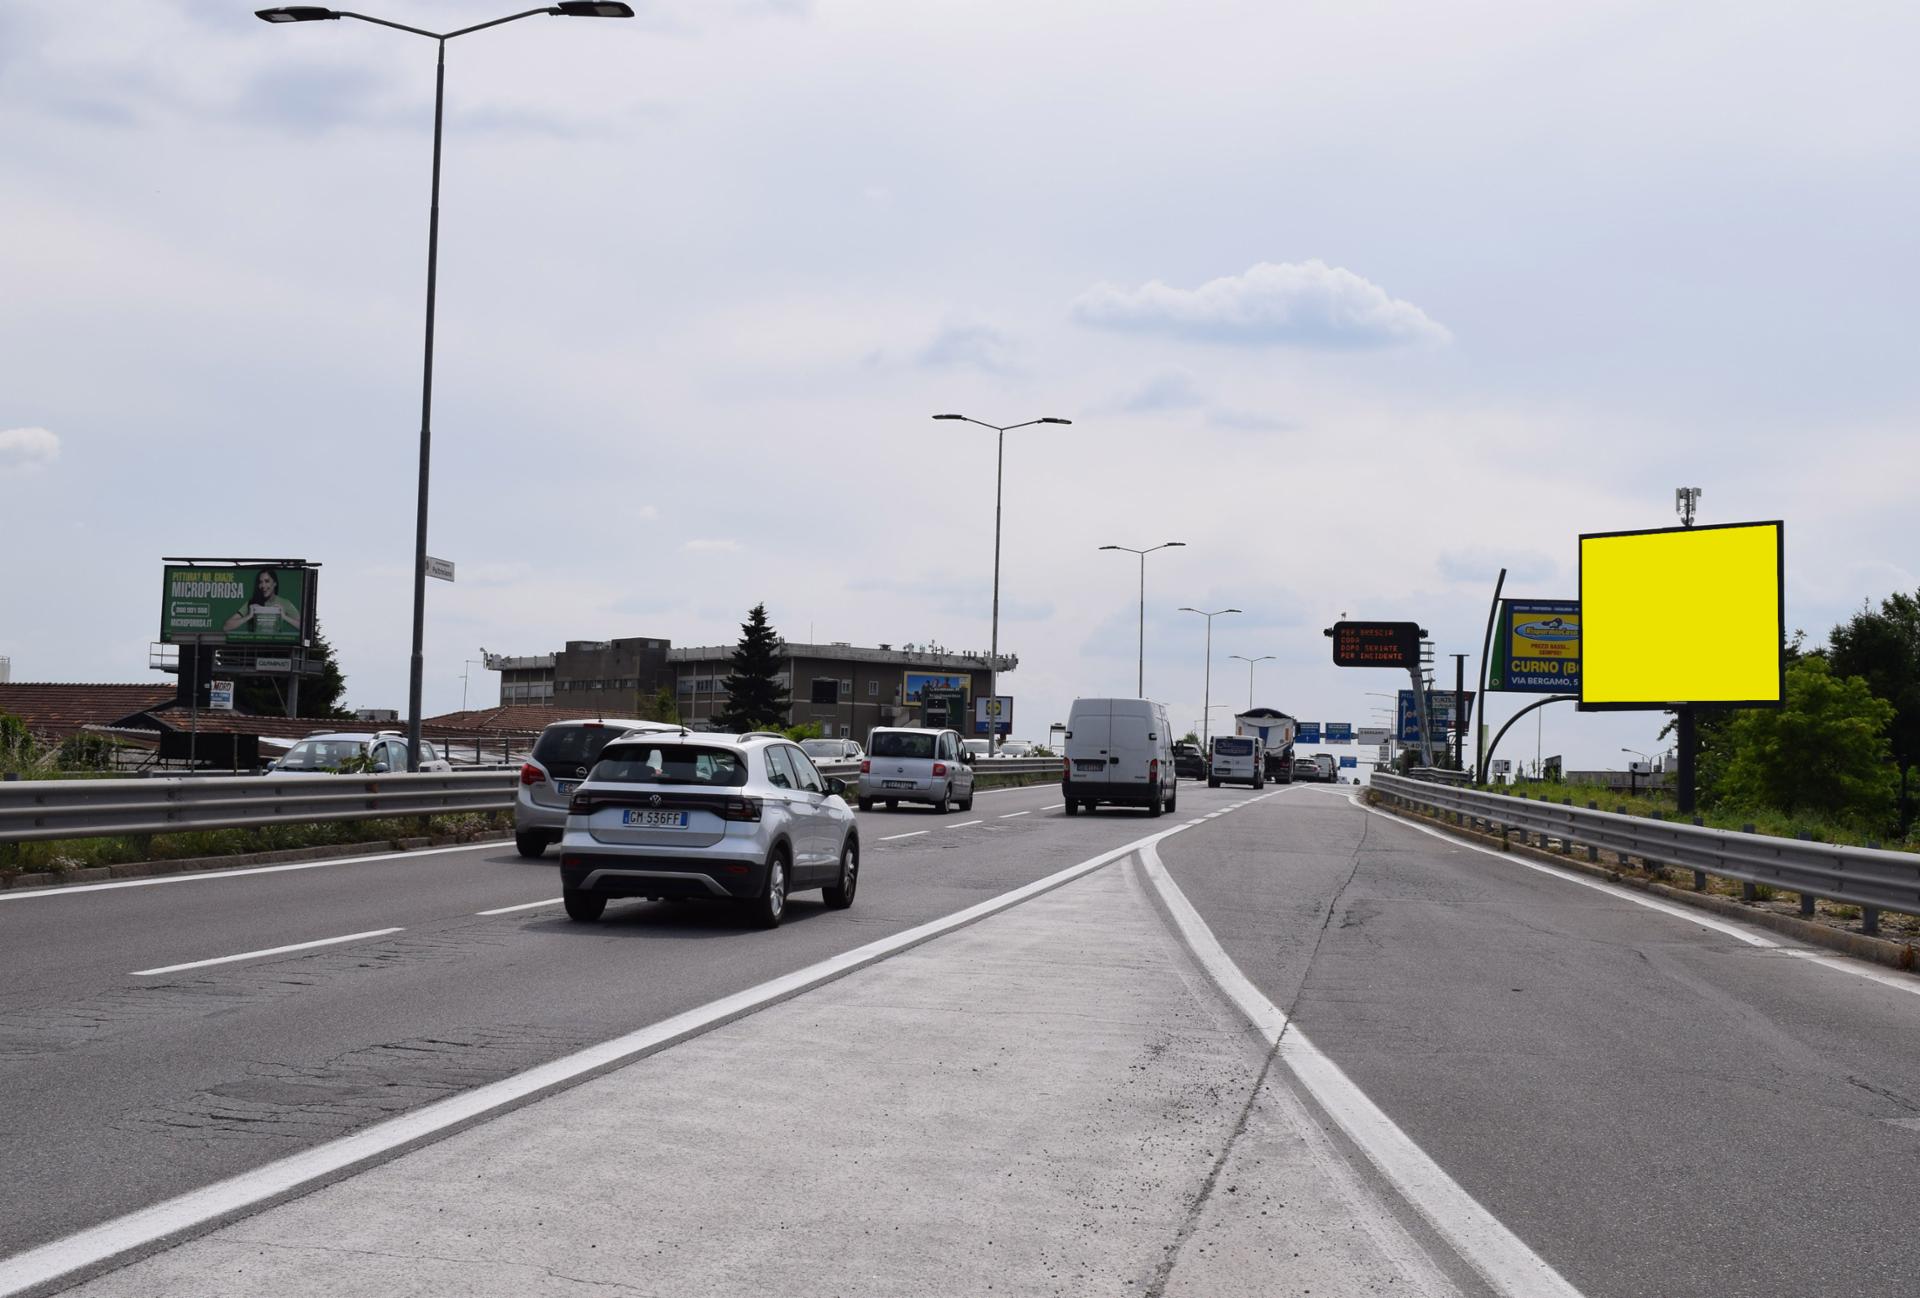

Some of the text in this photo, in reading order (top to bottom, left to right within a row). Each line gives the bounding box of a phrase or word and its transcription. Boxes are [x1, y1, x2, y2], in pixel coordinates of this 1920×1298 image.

[171, 582, 245, 599] MICROPOROSA
[1512, 661, 1579, 676] CURNO (B
[1512, 677, 1526, 685] VIA
[1528, 678, 1572, 686] BERGAMO,
[630, 811, 680, 824] GM 536FF
